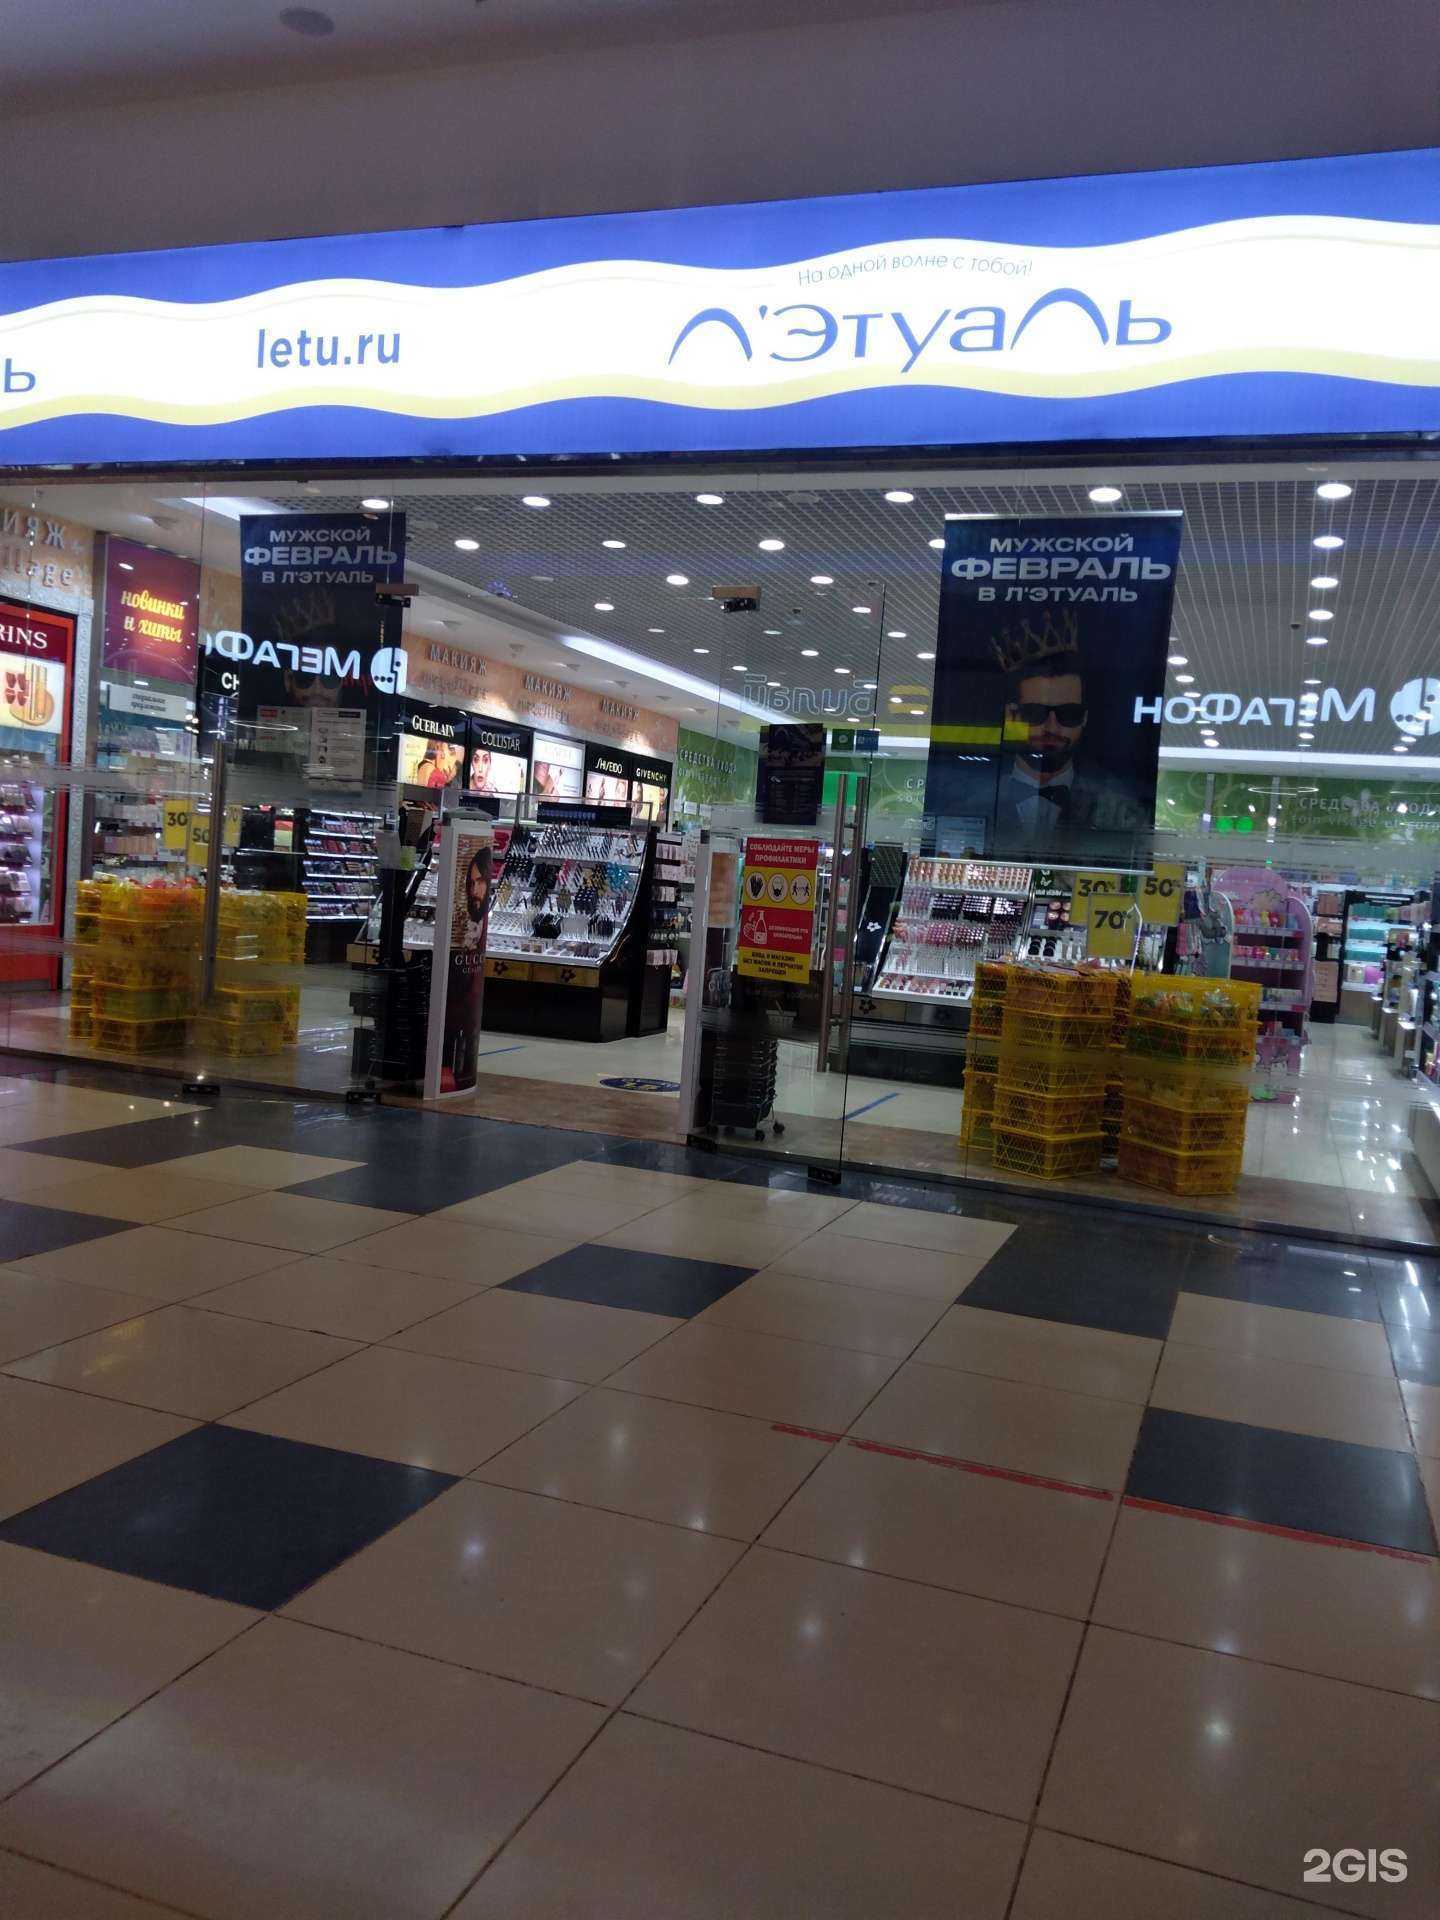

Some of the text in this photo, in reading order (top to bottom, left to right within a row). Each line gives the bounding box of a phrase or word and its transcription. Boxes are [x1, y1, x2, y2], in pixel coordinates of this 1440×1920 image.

[798, 255, 1033, 286] На одной волне с тобой!
[257, 328, 401, 368] letu.ru
[269, 526, 371, 543] МУЖСКОЙ
[989, 533, 1134, 553] МУЖСКОЙ
[244, 545, 398, 566] ФЕВРАЛЬ
[262, 571, 374, 585] В Л'ЭТУАЛЬ
[951, 556, 1172, 580] ФЕВРАЛЬ
[120, 588, 185, 620] новинки
[978, 586, 1138, 602] В Л'ЭТУАЛЬ
[138, 619, 184, 643] хиты
[430, 643, 488, 677] МАКИЯЖ
[412, 714, 455, 738] GUERLAIN
[481, 731, 521, 752] COLLISTAR
[635, 767, 667, 783] GIVENCHY
